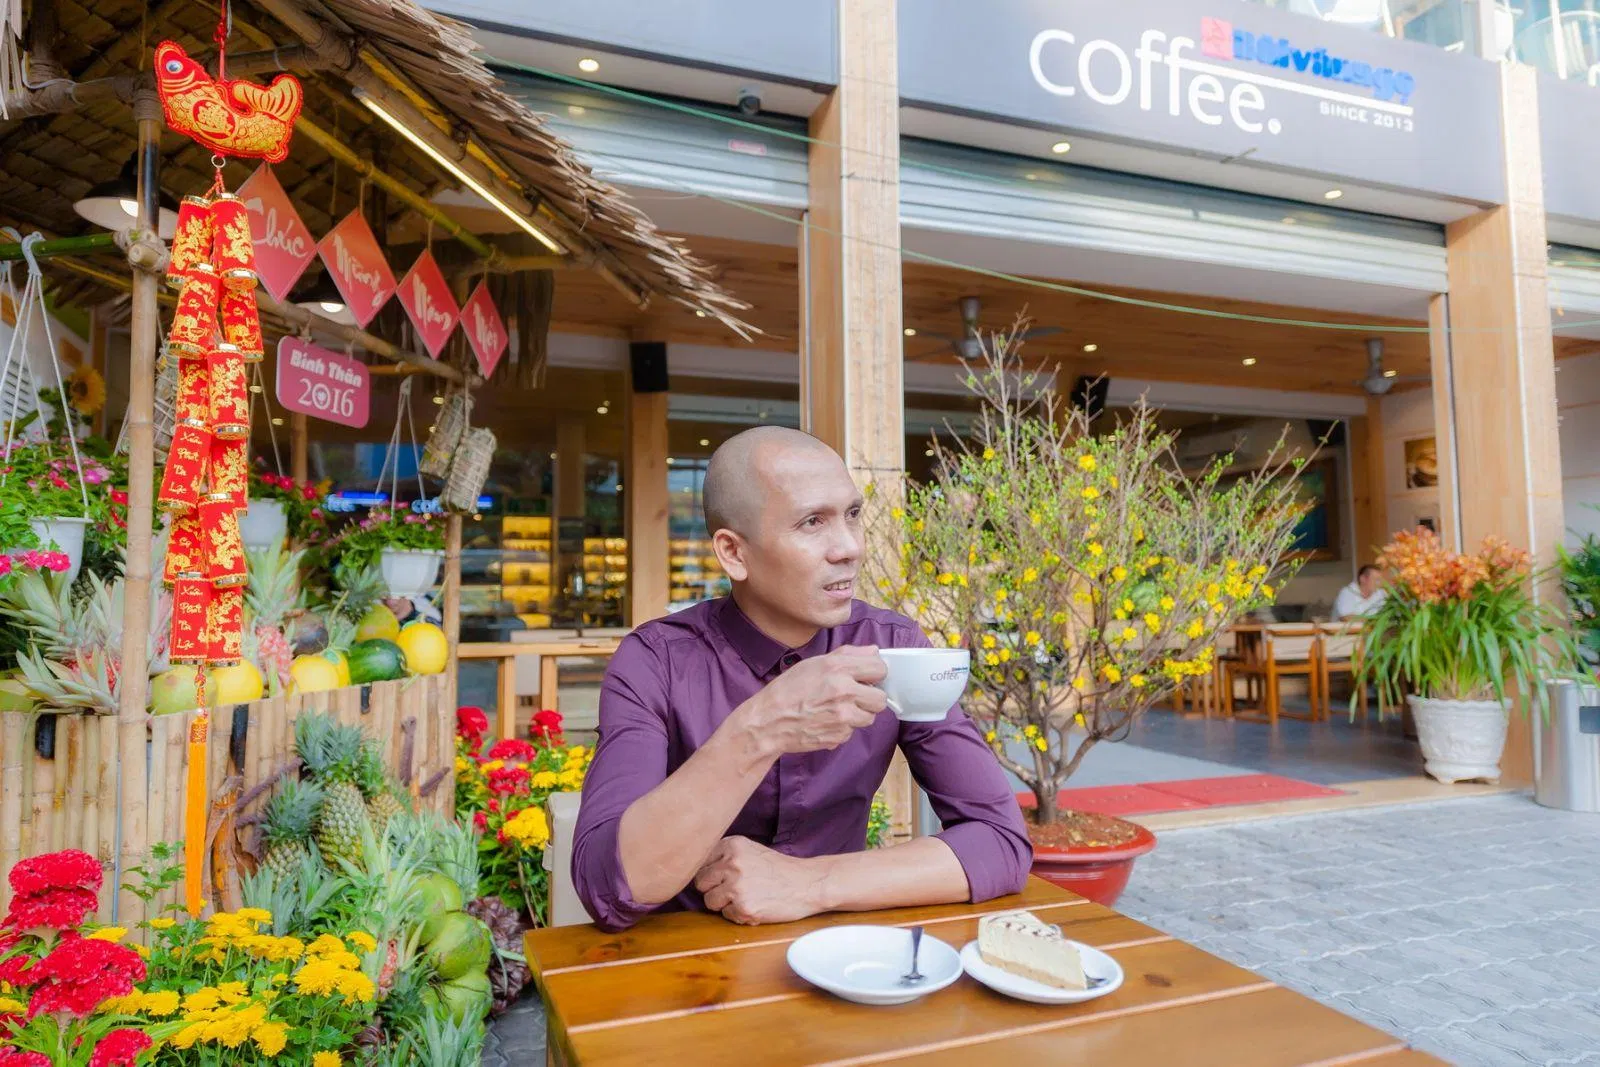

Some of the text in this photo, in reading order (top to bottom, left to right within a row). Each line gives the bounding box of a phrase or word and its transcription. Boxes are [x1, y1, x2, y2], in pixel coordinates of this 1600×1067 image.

[1319, 101, 1414, 133] SINCE 2013
[290, 349, 362, 388] Bính Thân
[298, 378, 355, 417] 2016
